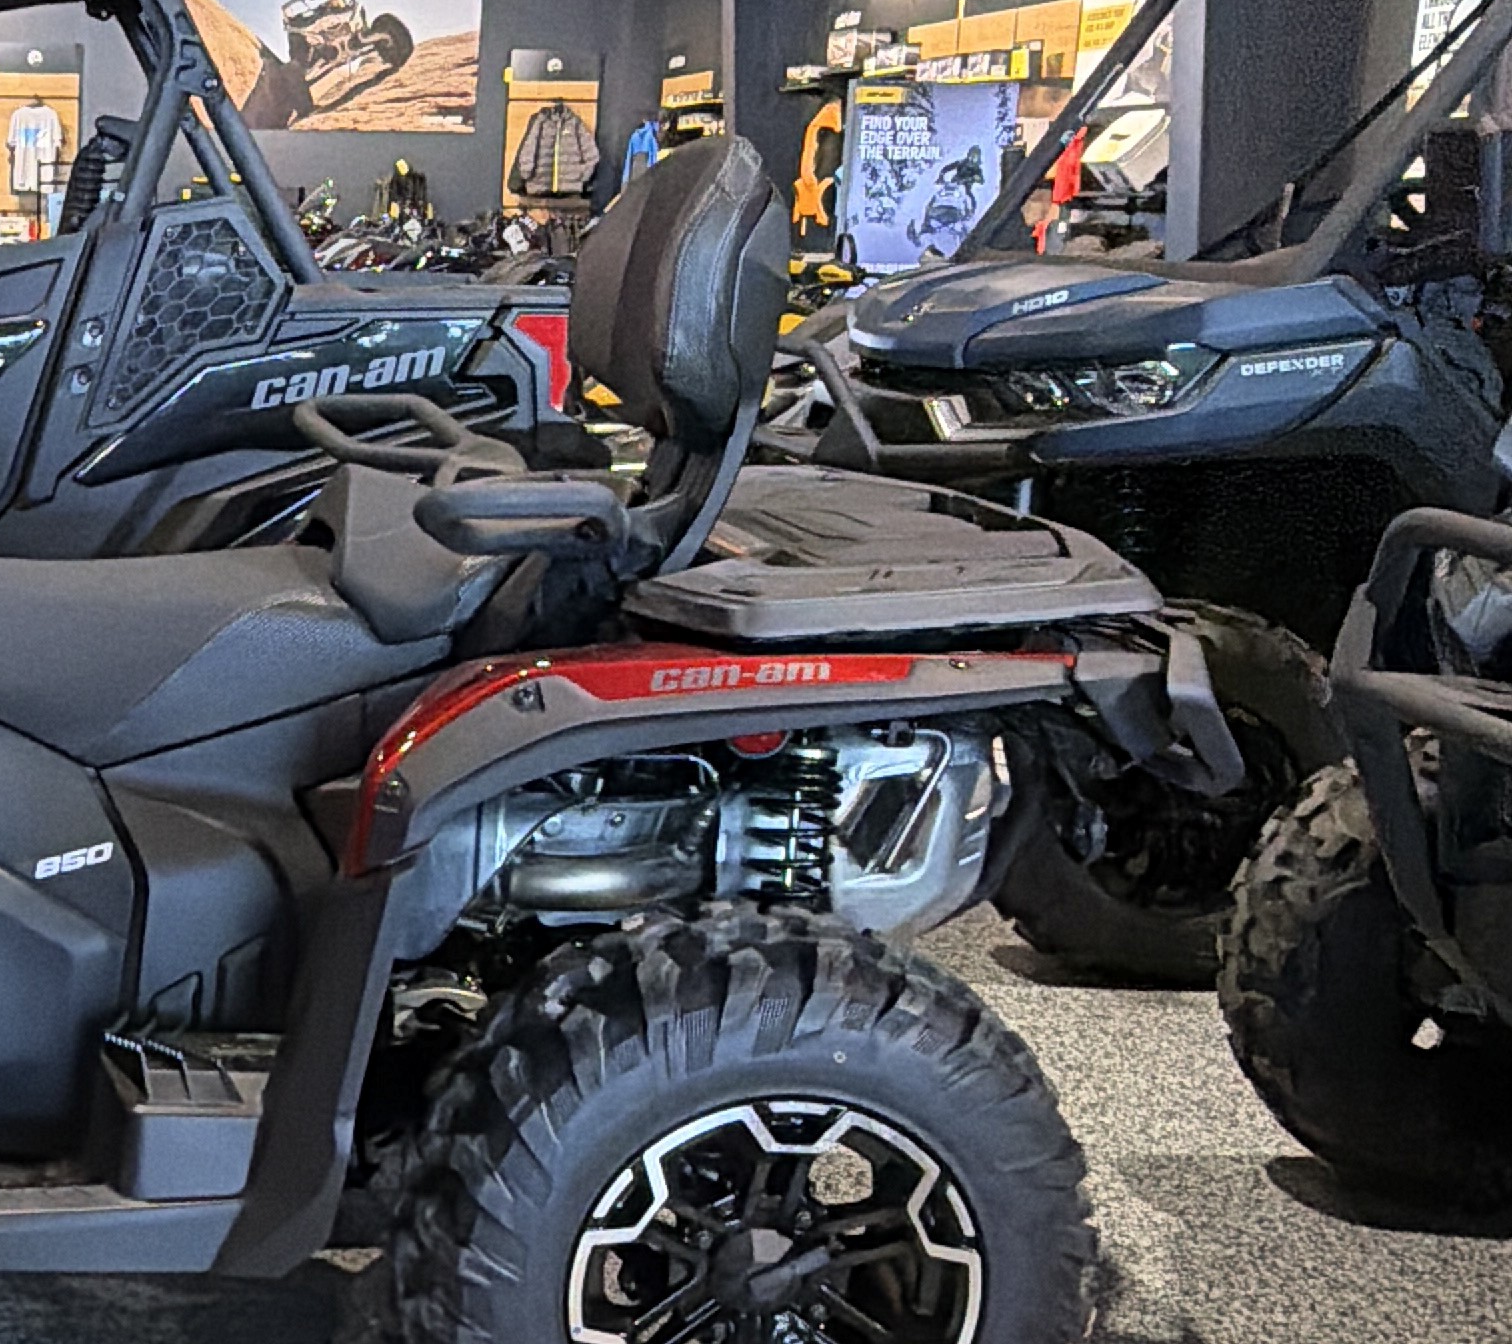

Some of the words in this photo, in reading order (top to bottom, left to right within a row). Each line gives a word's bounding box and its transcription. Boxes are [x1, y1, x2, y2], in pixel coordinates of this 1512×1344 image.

[860, 115, 891, 131] FIND
[894, 115, 928, 131] YOUR
[859, 131, 894, 145] EDGE
[896, 131, 931, 146] OVER
[859, 146, 884, 161] THE
[1011, 290, 1070, 314] HD10
[1240, 354, 1344, 376] DEFENDER
[250, 346, 446, 410] can-am
[650, 662, 831, 692] can-am
[34, 842, 114, 880] 850
